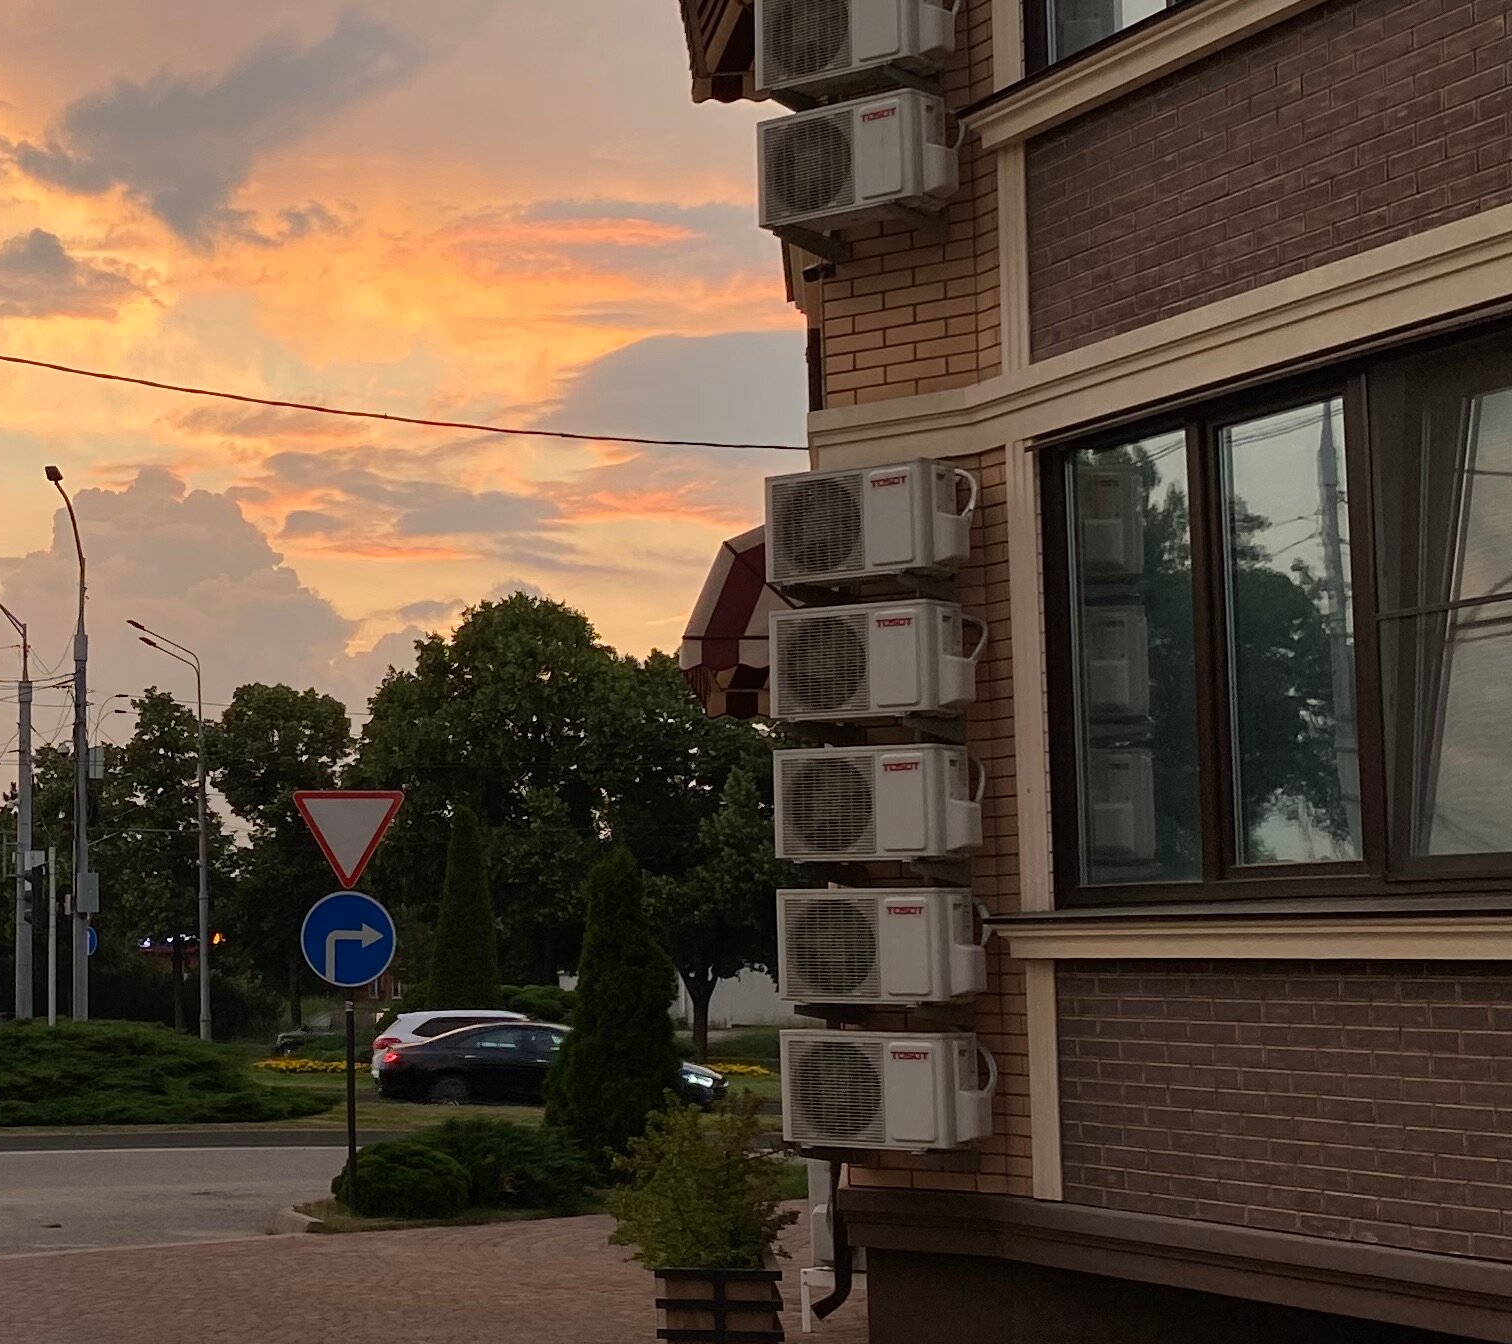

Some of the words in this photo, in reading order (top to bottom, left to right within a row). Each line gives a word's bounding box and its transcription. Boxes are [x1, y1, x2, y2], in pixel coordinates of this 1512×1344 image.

[861, 107, 896, 122] TOSOT
[871, 476, 907, 488] TOSOT
[876, 617, 912, 627] TOSOT
[883, 761, 920, 772] TOSOT
[887, 906, 924, 916] TOSOT
